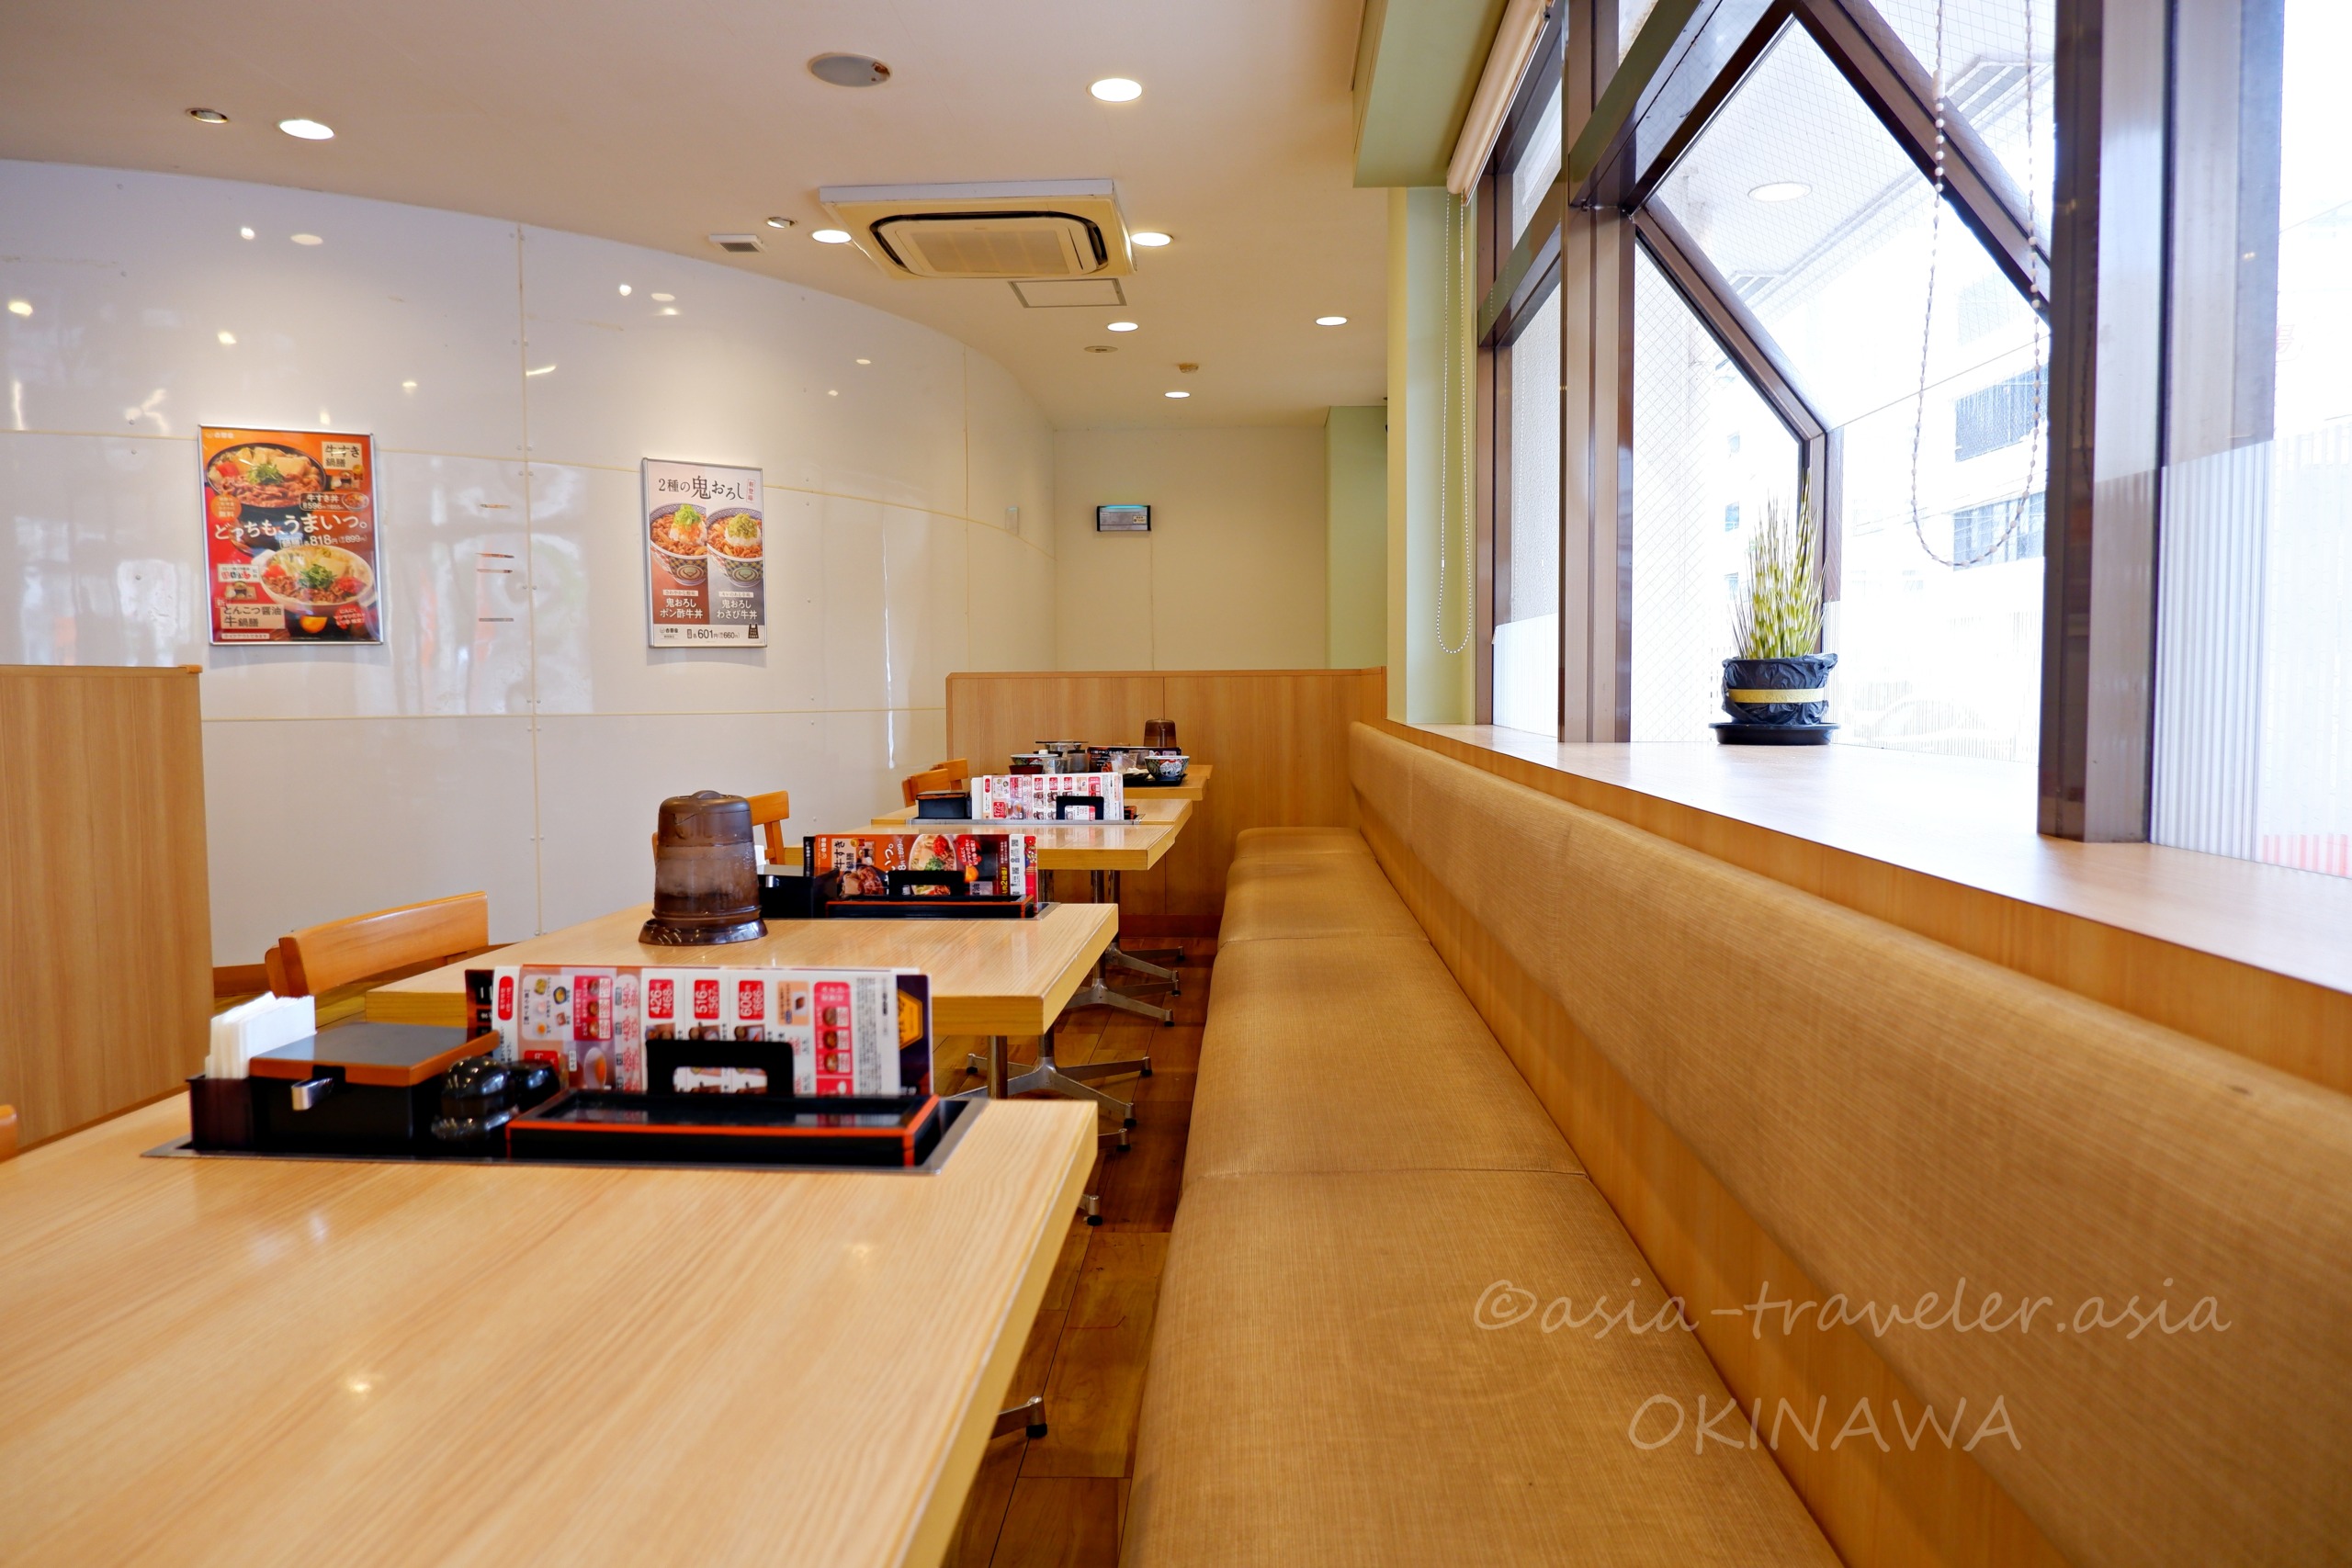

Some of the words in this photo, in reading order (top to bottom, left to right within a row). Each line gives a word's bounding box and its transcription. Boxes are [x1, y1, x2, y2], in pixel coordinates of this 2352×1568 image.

[658, 475, 745, 501] 2種の鬼おろし
[666, 598, 696, 608] 鬼おろし
[721, 600, 752, 609] 鬼おろし
[660, 608, 704, 619] ポン酢牛丼
[717, 610, 758, 620] わさび牛丼
[833, 840, 845, 869] 牛すき
